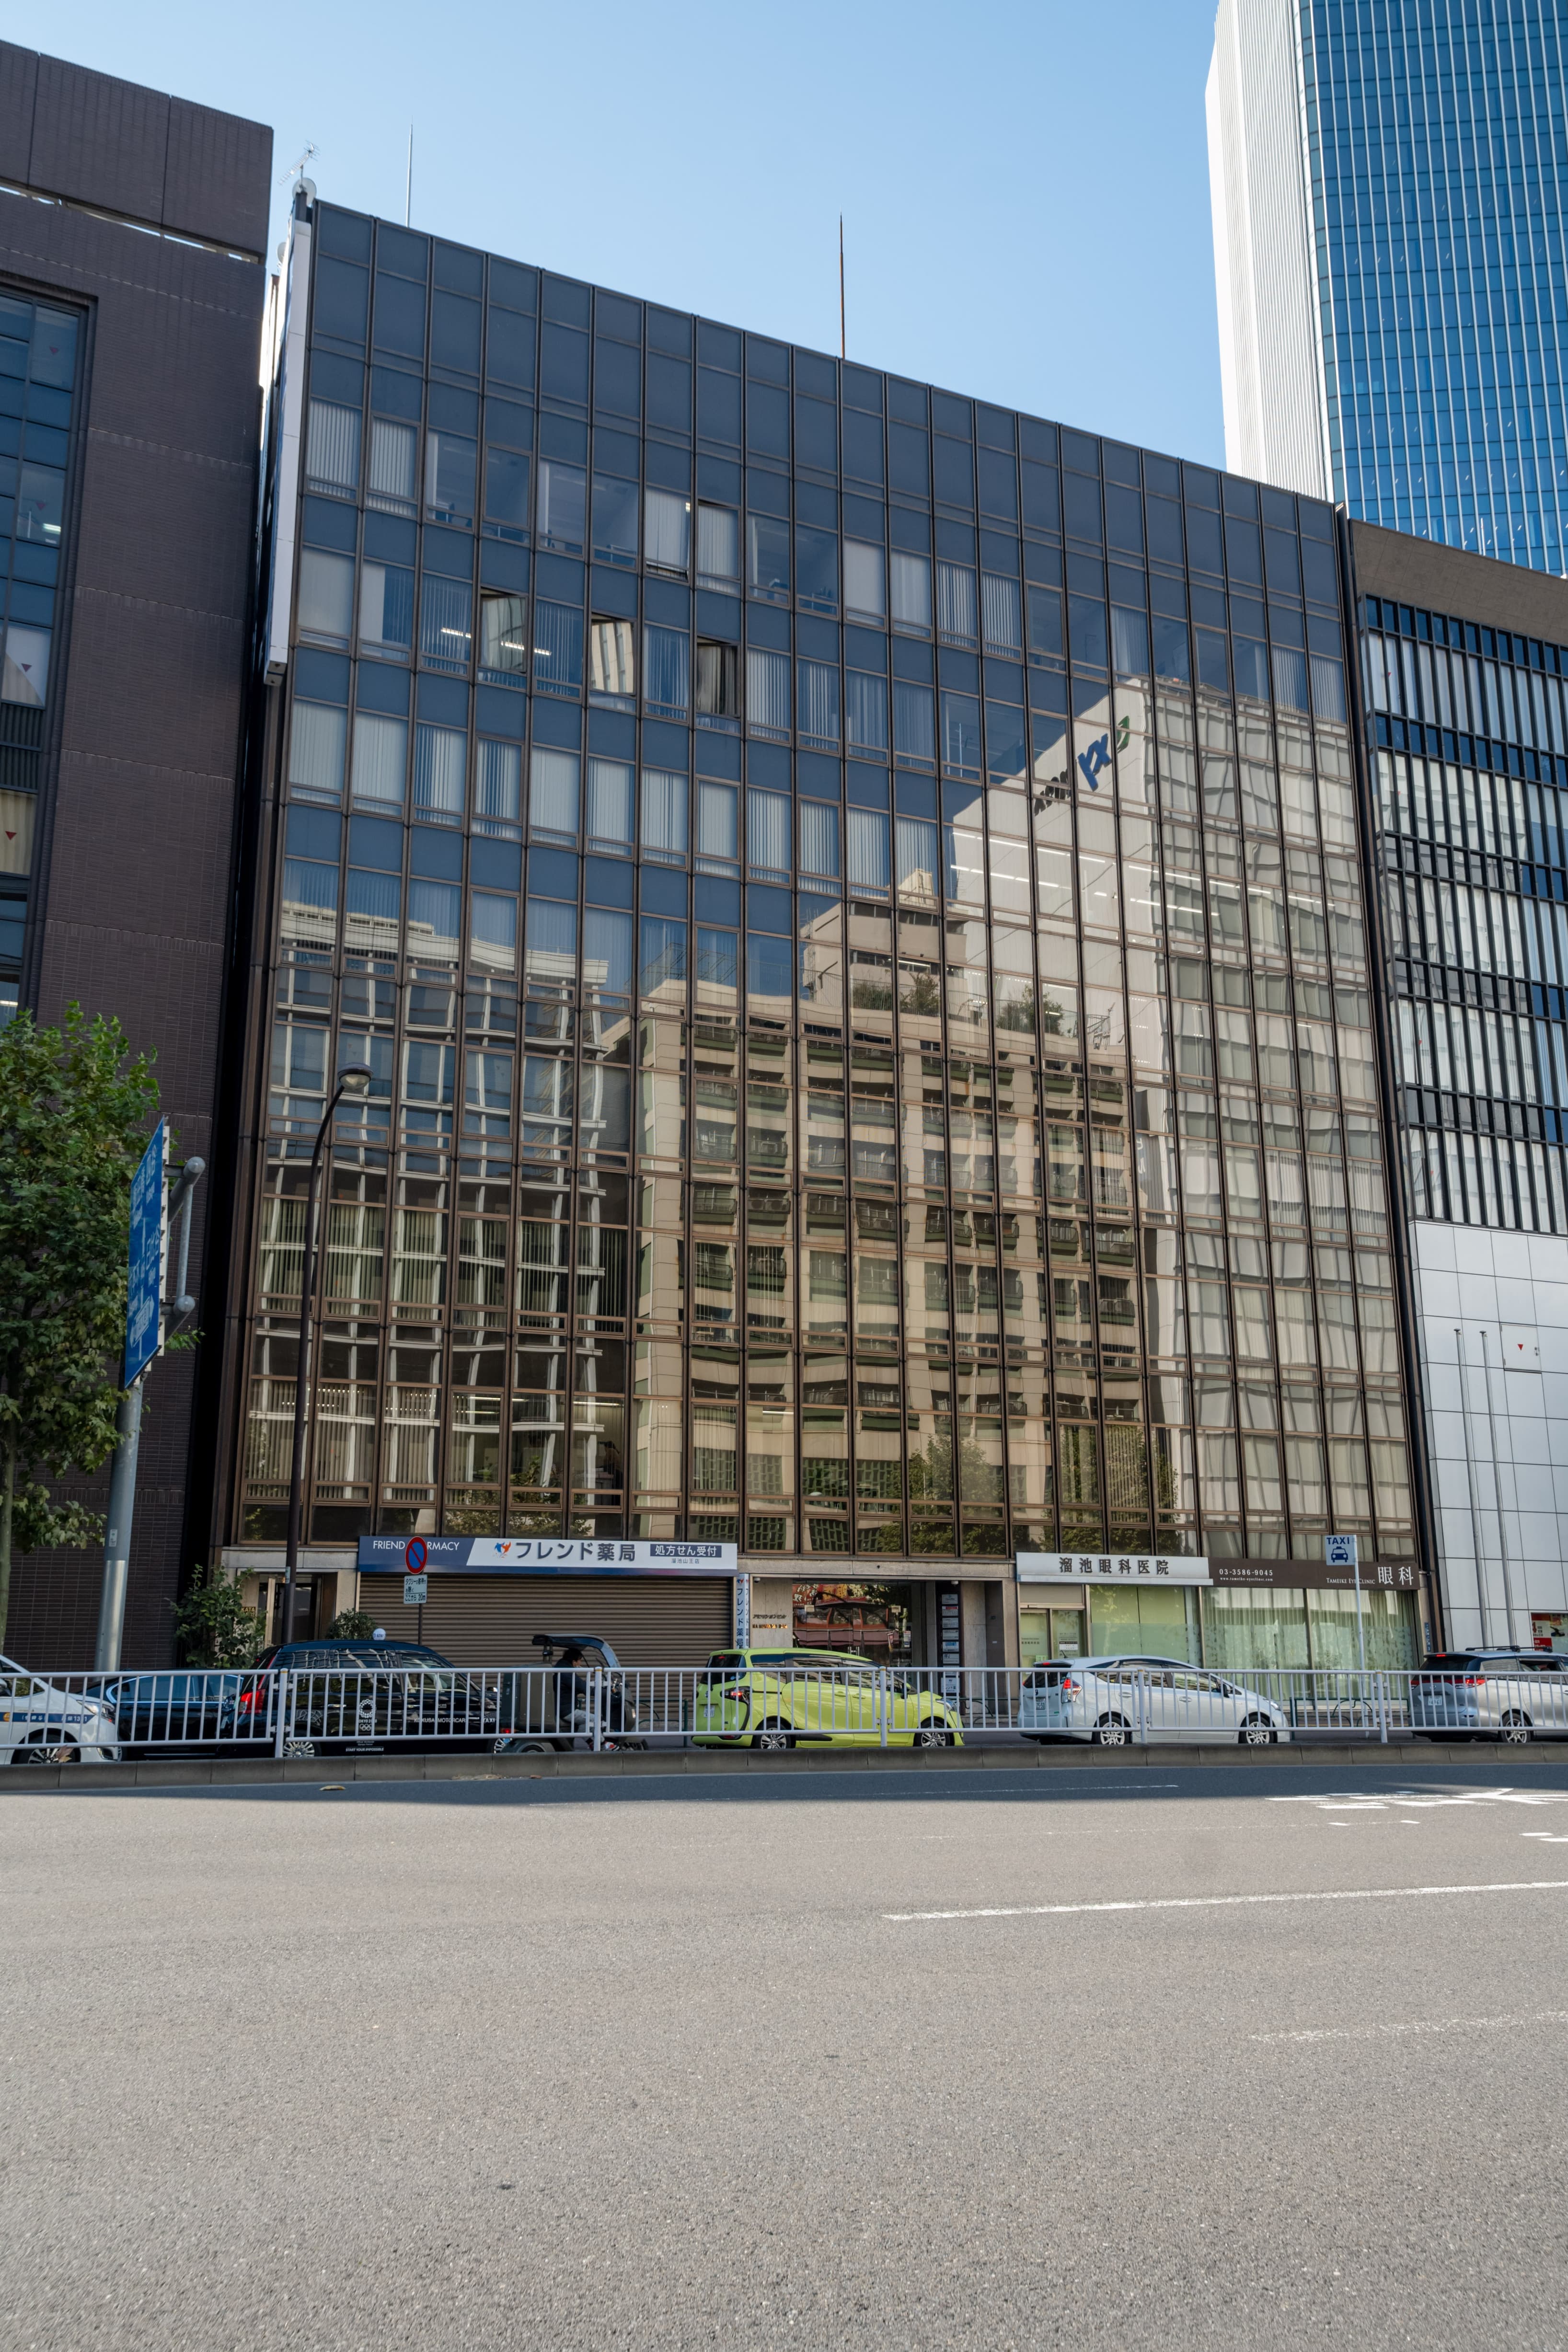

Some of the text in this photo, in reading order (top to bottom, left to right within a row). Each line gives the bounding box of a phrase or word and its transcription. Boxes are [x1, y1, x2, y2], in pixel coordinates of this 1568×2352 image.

[373, 1540, 460, 1551] FRIEND RMACY
[1326, 1536, 1350, 1545] TAXI
[515, 1541, 636, 1562] フレンド薬局
[655, 1545, 717, 1556] 処方せん受付
[1059, 1556, 1170, 1576] 溜池眼科医院
[1377, 1566, 1414, 1586] 眼科
